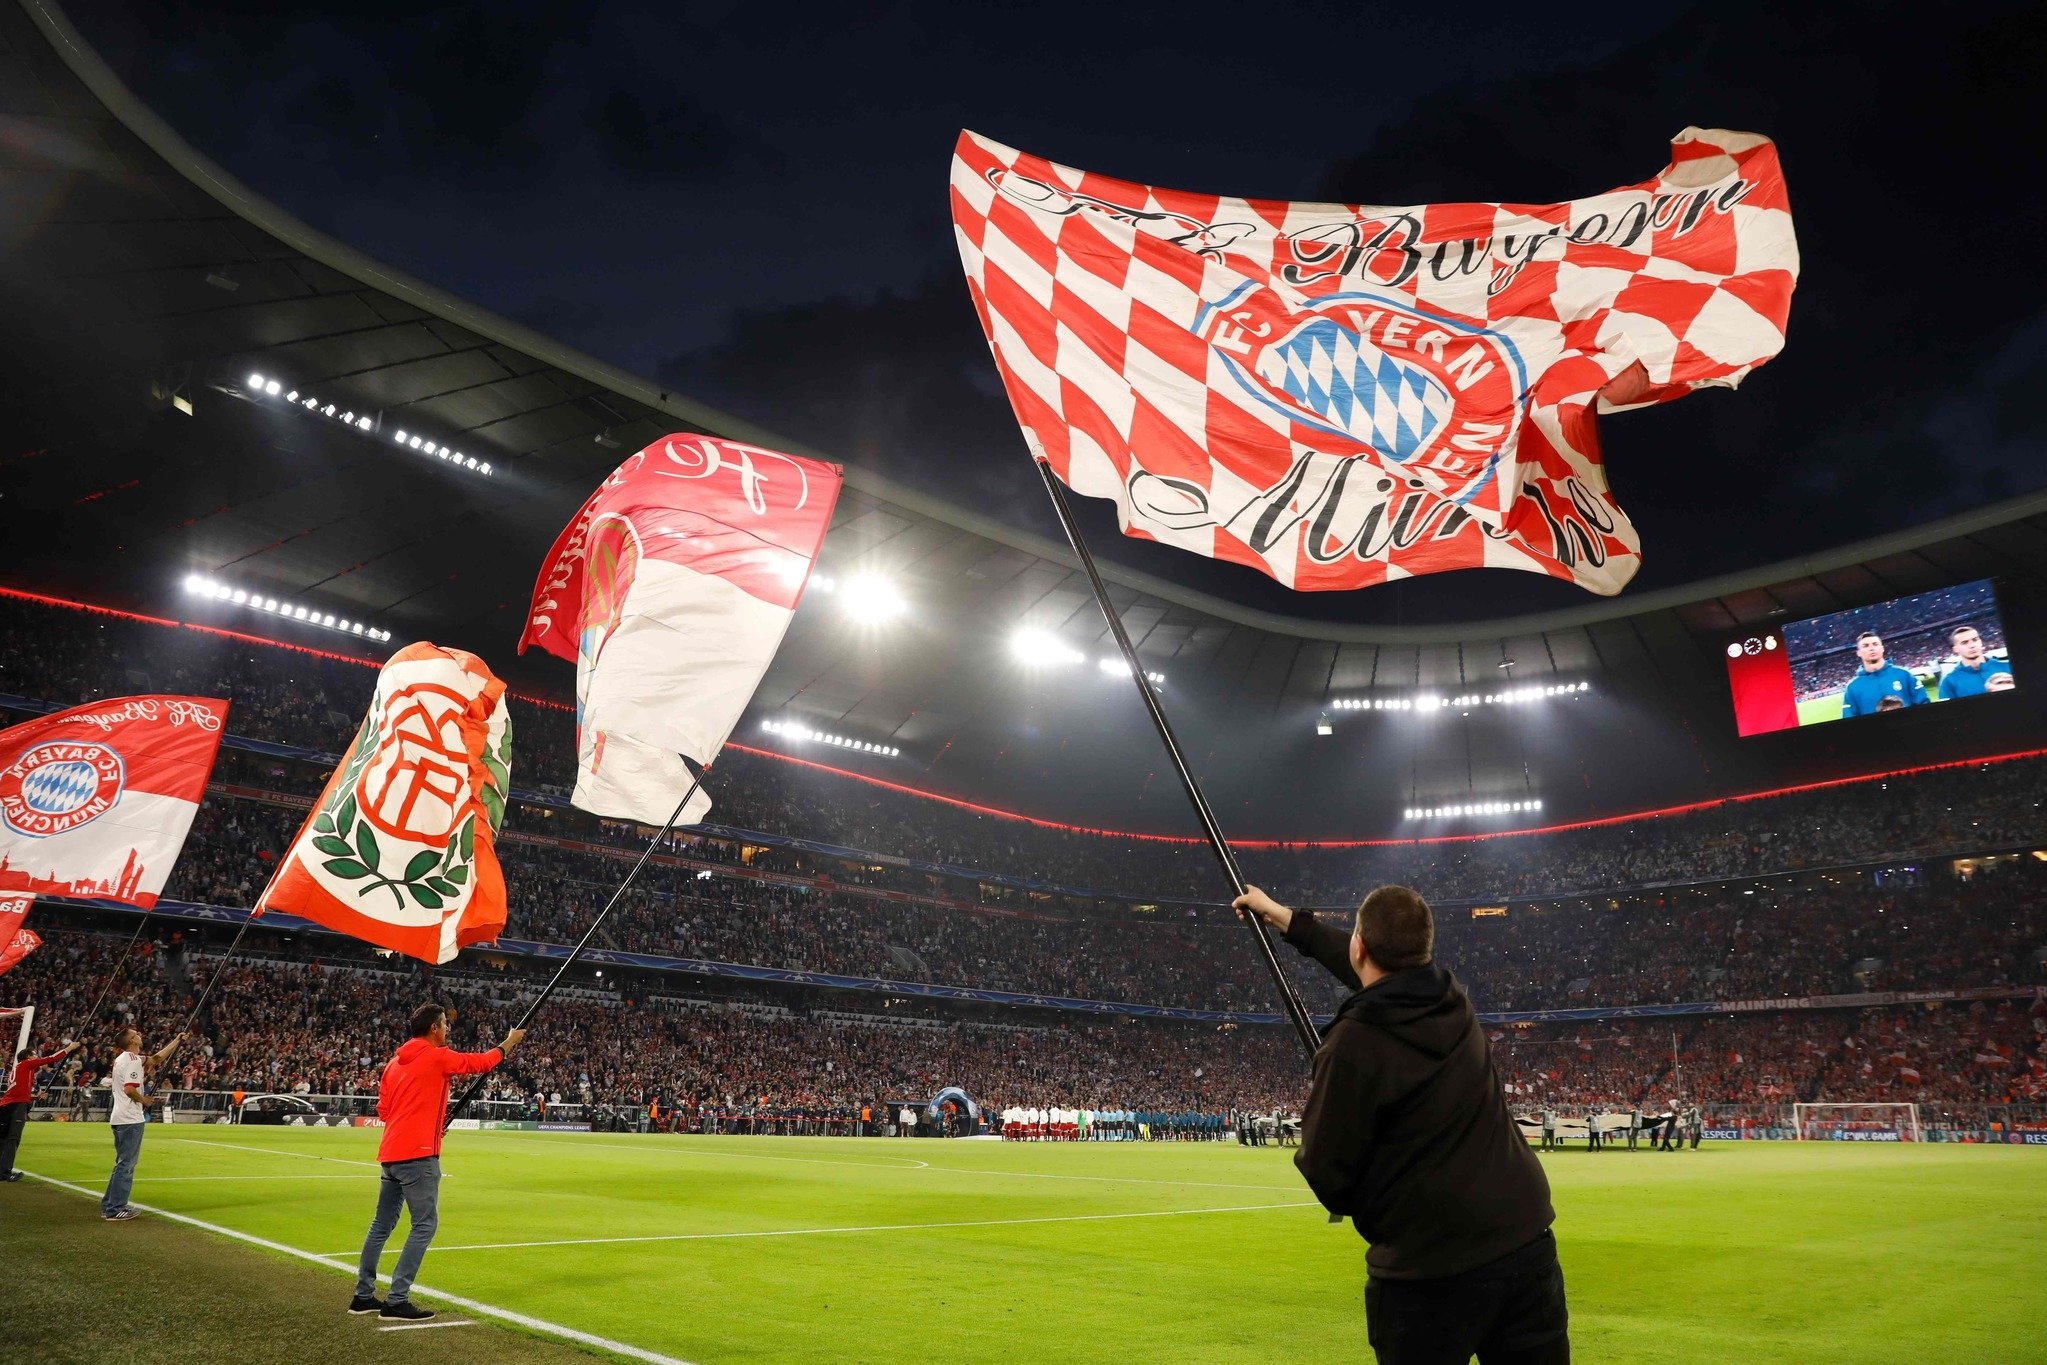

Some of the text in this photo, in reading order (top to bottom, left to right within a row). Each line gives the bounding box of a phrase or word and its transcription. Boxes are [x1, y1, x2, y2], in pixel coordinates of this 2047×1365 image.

[1281, 178, 1757, 297] Bayern
[1212, 309, 1495, 393] FC YERN
[205, 783, 227, 792] CHEN
